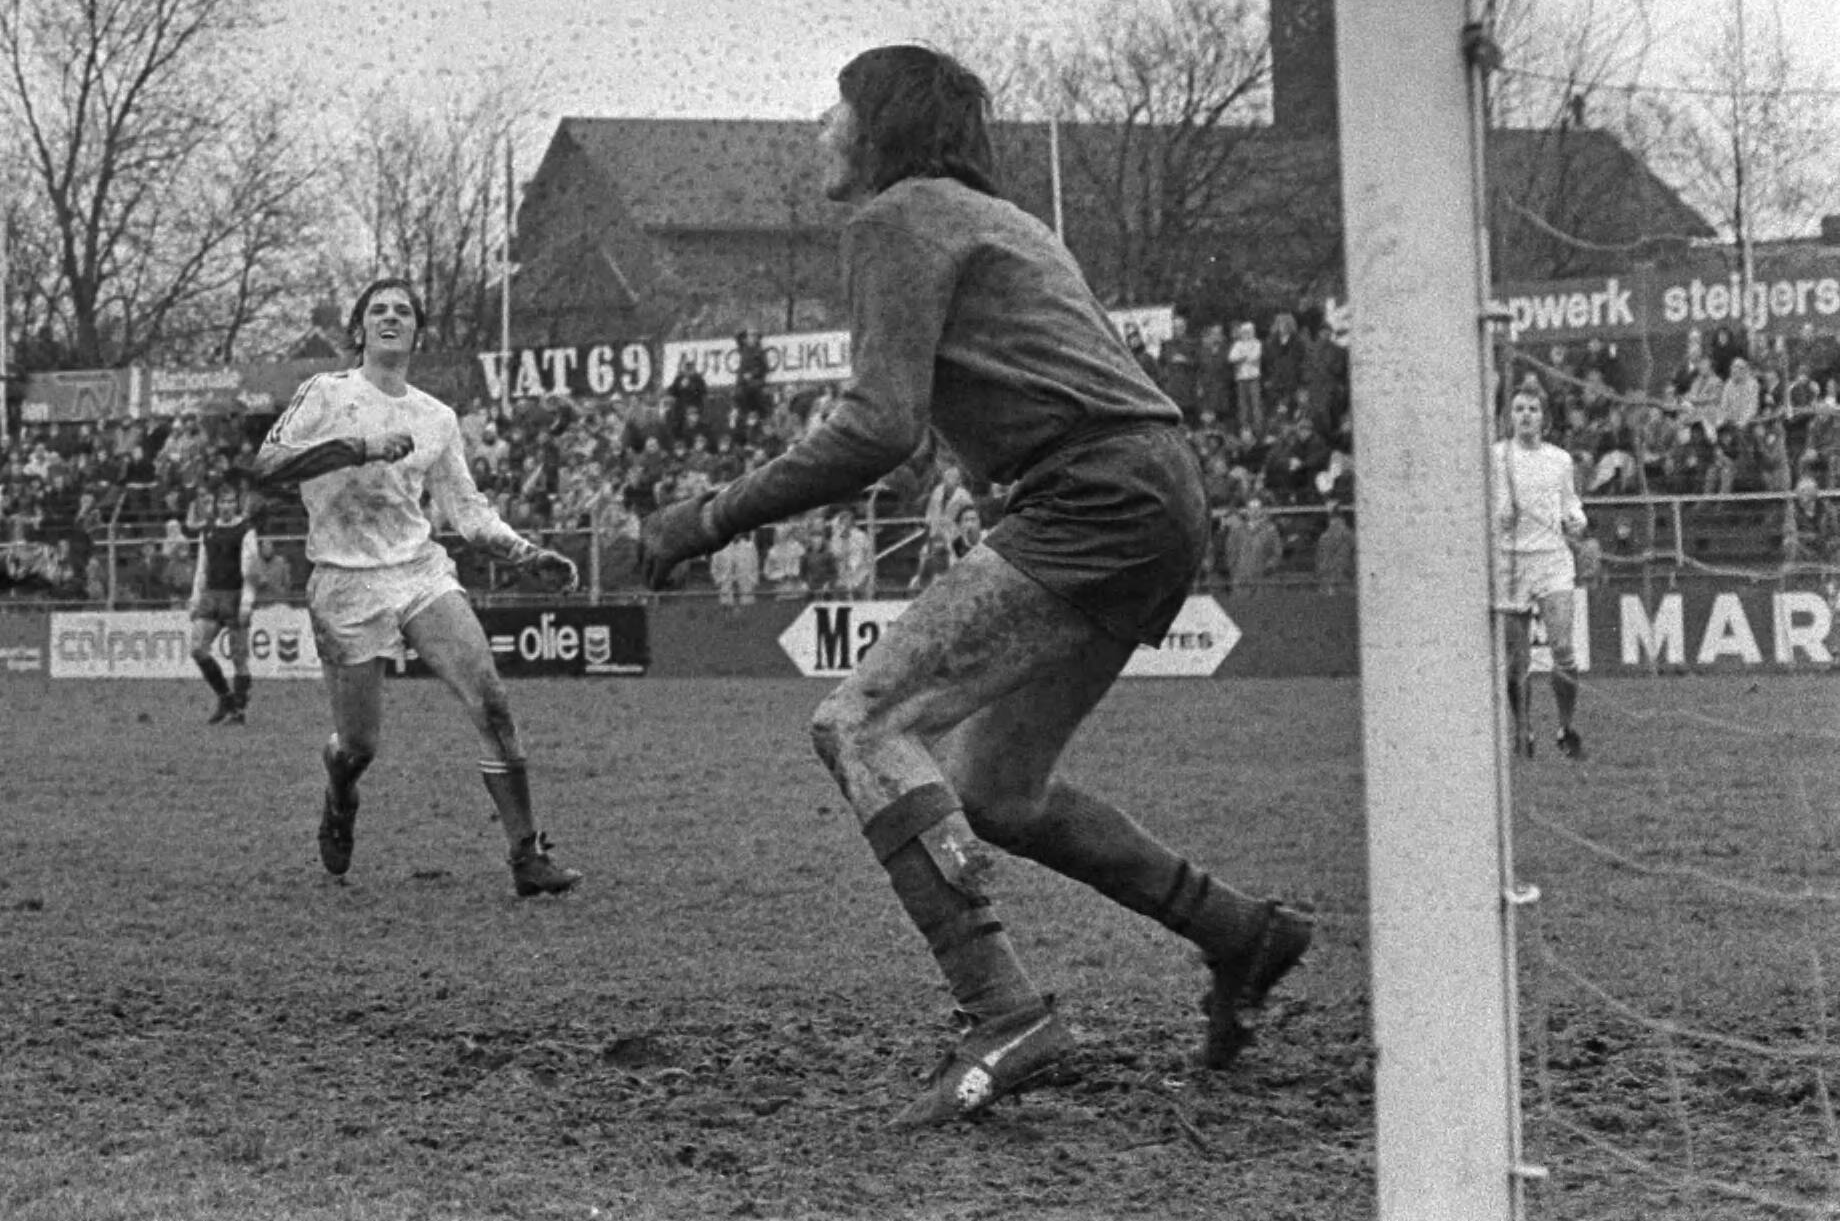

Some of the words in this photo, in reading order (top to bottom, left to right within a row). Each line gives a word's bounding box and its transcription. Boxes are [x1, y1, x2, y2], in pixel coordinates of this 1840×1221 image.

[1510, 278, 1635, 342] pwerk
[1663, 272, 1840, 330] steigers
[477, 346, 578, 399] VAT
[586, 342, 652, 394] 69
[519, 612, 580, 661] olie
[1619, 592, 1835, 665] MAR
